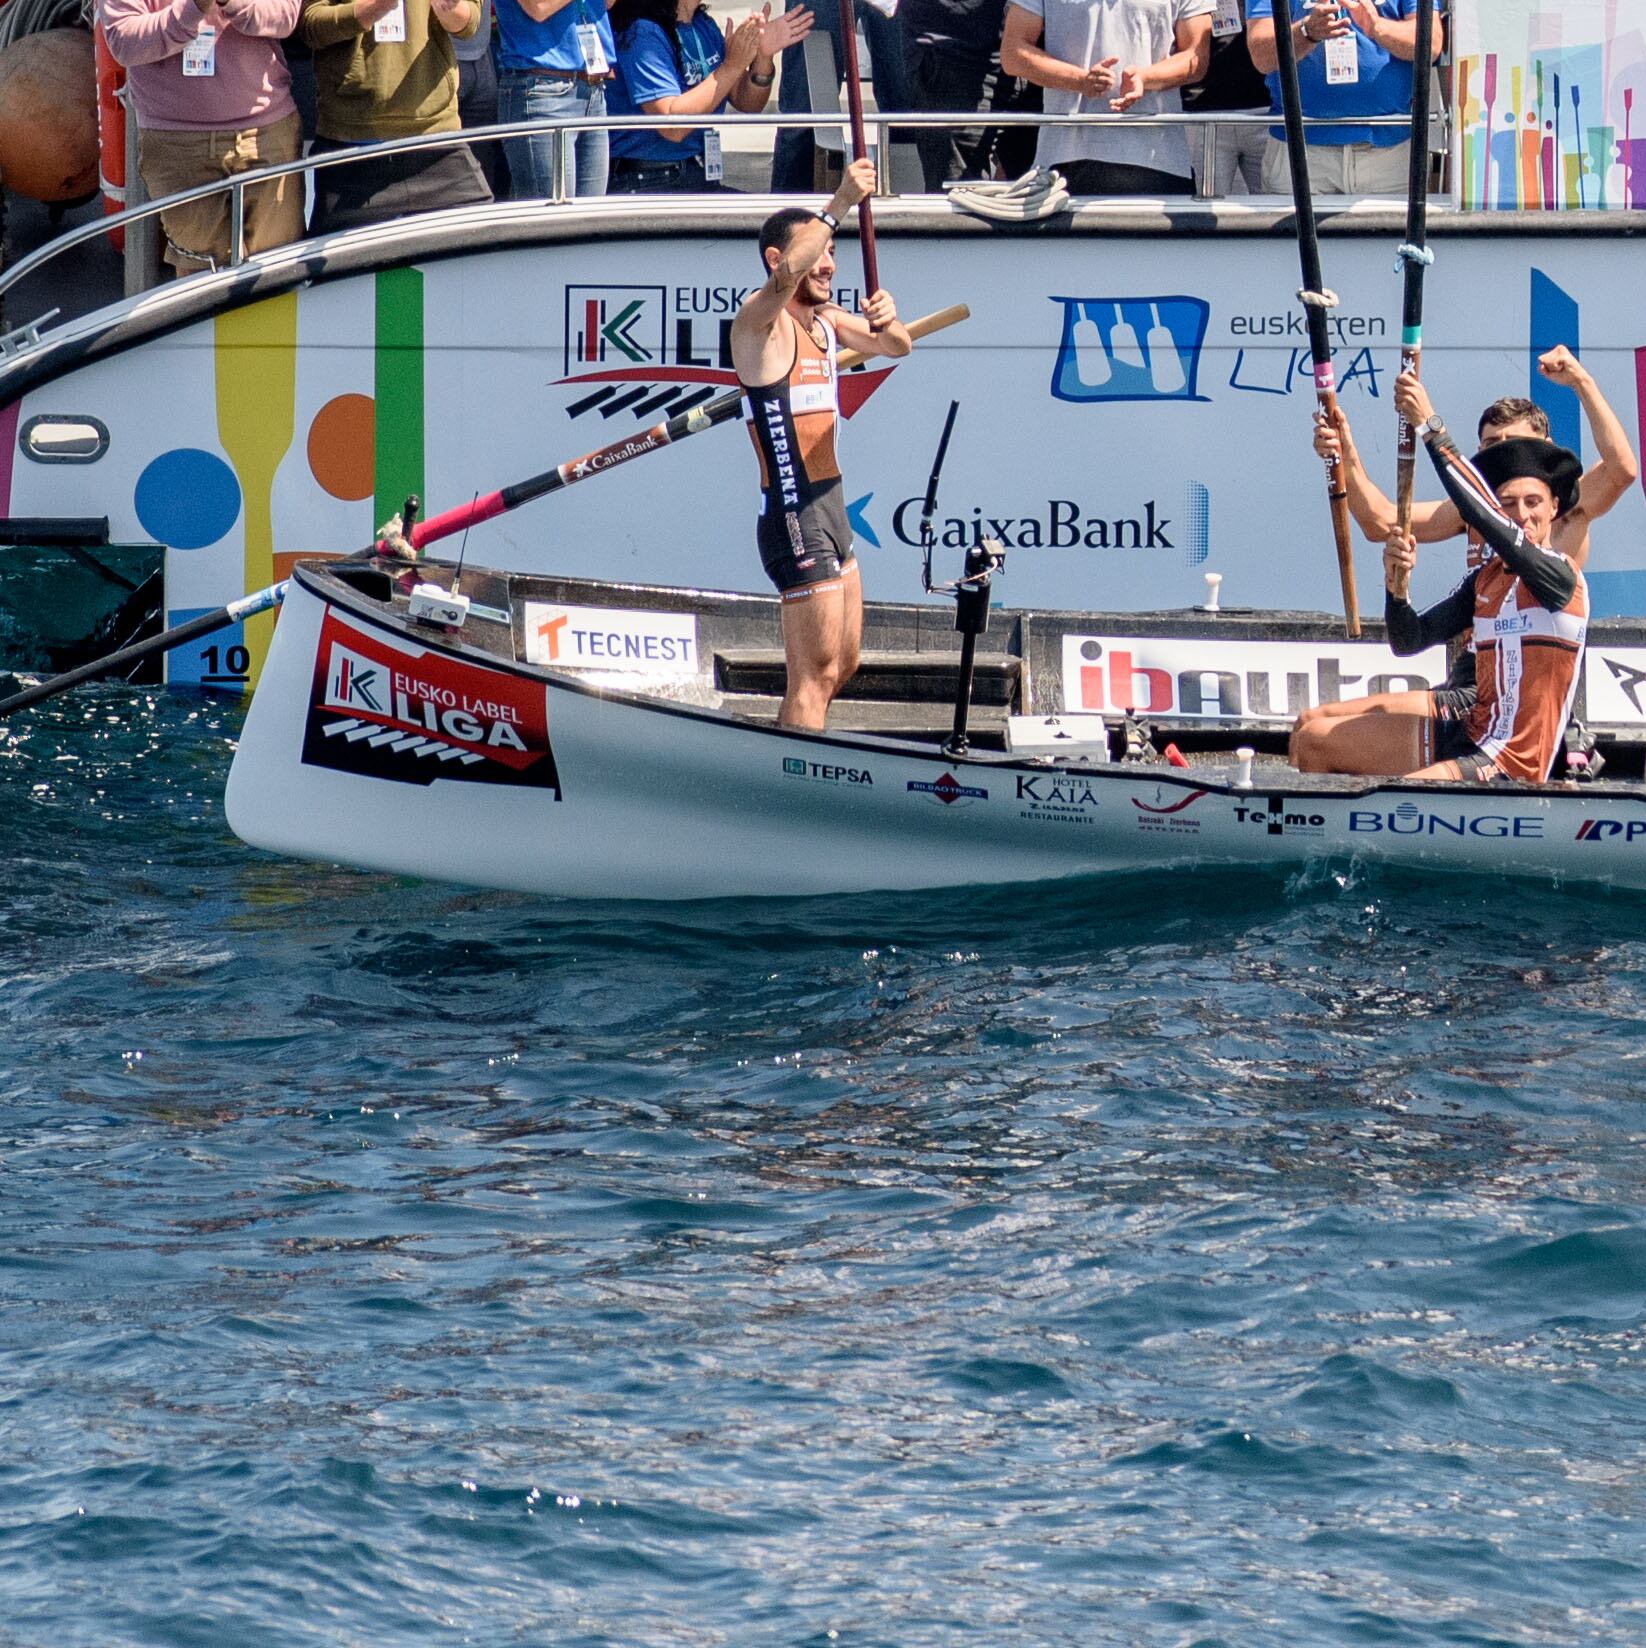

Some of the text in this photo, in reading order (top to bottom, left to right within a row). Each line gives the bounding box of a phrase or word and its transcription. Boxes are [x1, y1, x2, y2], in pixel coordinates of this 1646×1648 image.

[675, 287, 743, 313] EUSK
[591, 434, 658, 471] CaixaBank
[892, 497, 1176, 550] CaixaBank
[200, 646, 250, 675] 10
[571, 630, 694, 662] TECNEST
[395, 672, 523, 724] EUSKO LABEL
[395, 693, 528, 753] LIGA
[807, 762, 874, 784] TEPSA
[1052, 777, 1092, 789] HOTEL
[913, 782, 983, 797] BILBAO TRUCK
[1016, 774, 1098, 805] KAIA
[1020, 811, 1095, 824] RESTAURANTE
